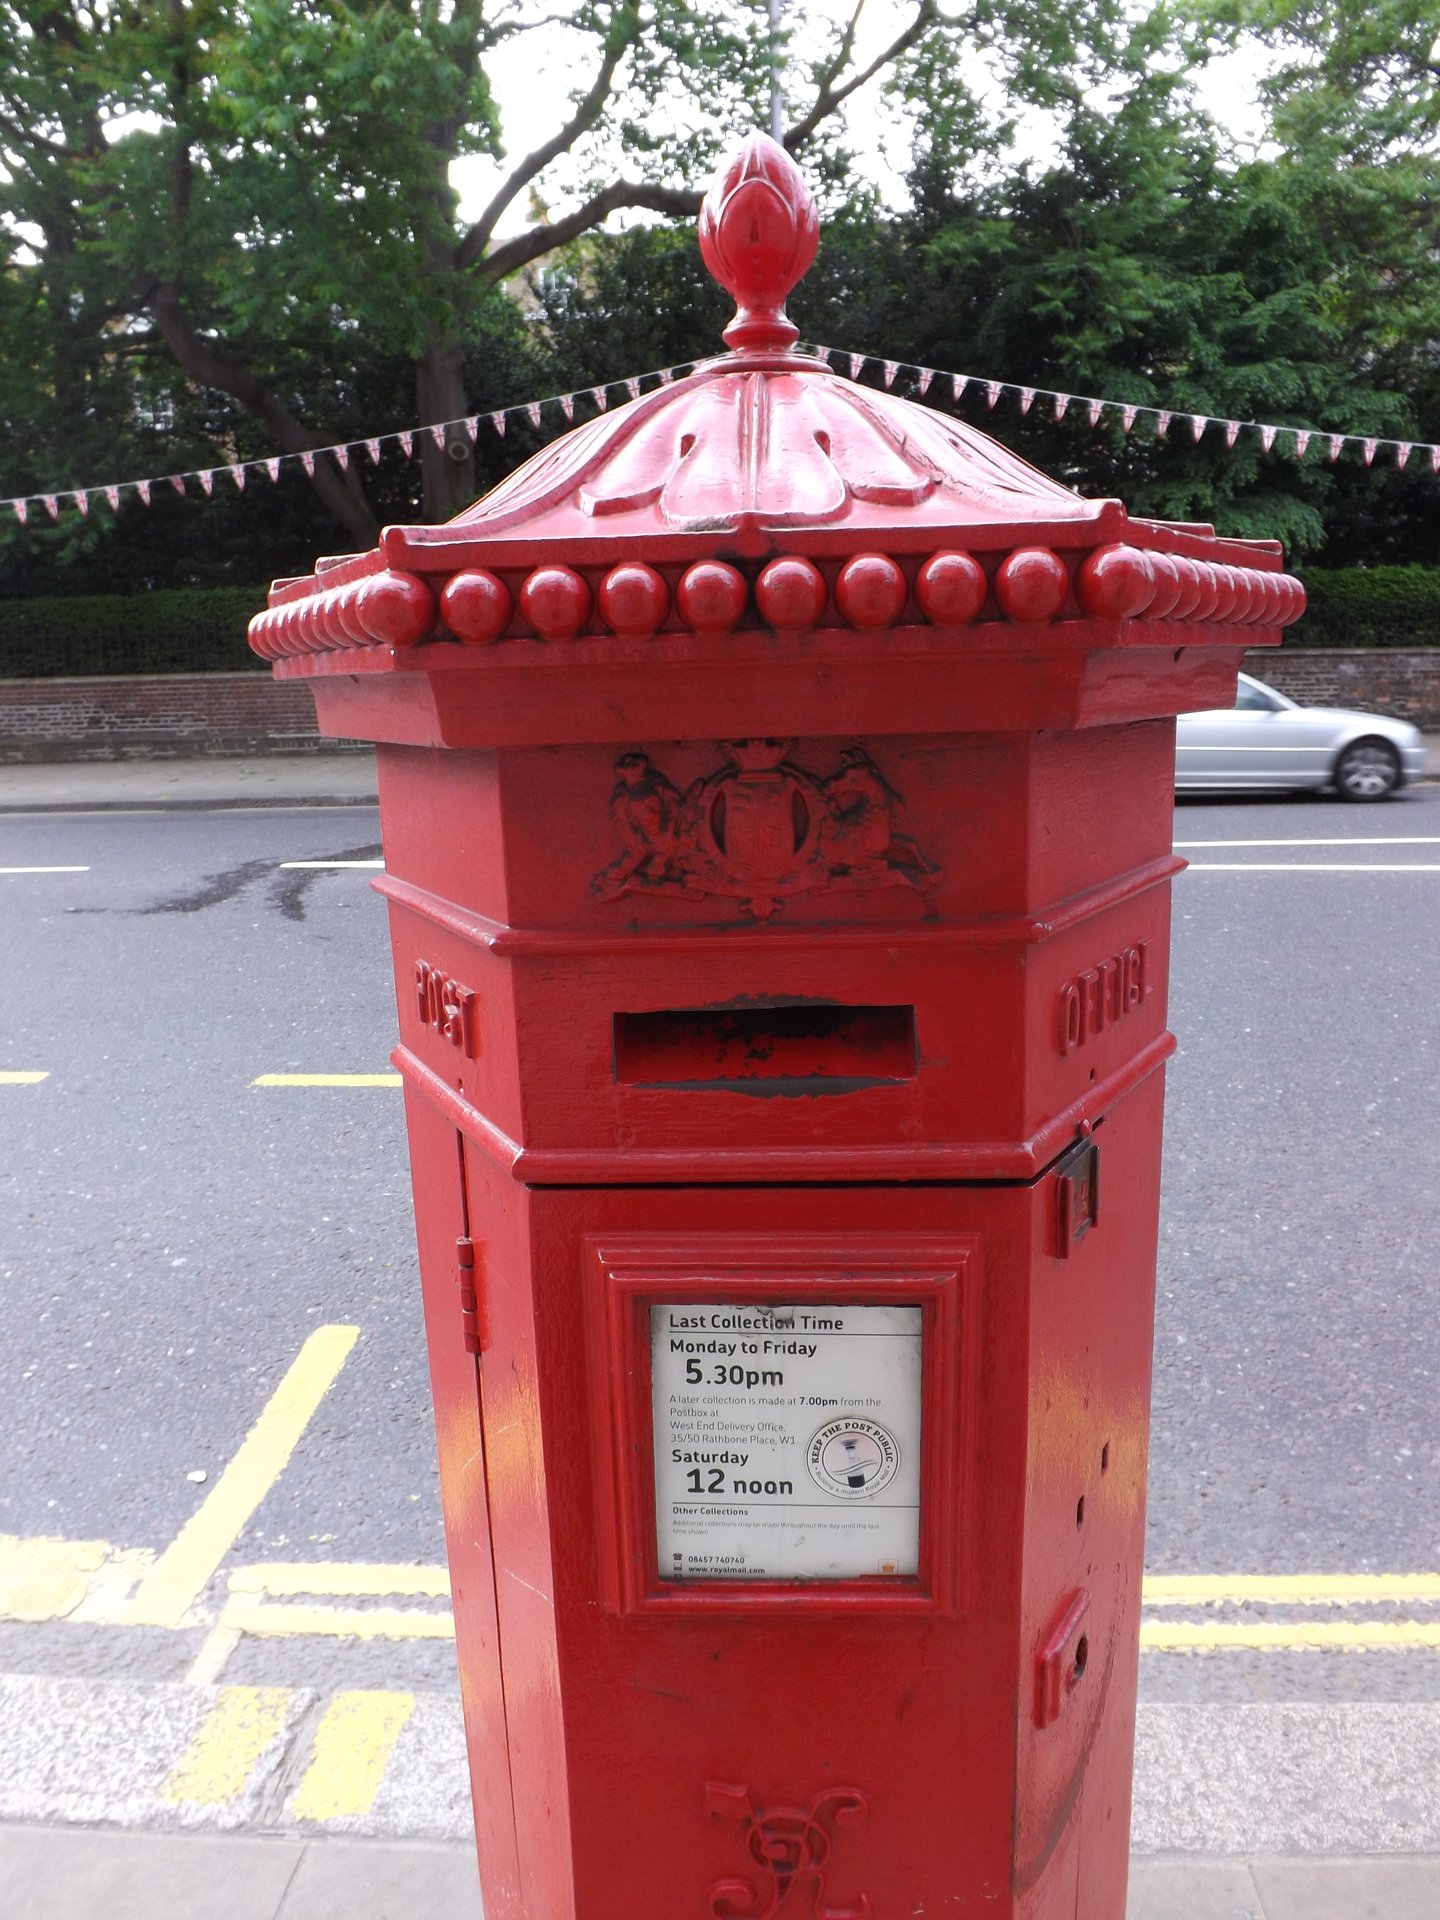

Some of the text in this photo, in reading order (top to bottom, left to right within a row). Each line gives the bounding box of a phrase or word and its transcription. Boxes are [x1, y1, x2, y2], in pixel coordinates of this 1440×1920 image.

[415, 958, 481, 1060] POST
[669, 1314, 844, 1330] Last Collection Time
[670, 1339, 817, 1357] Monday to Friday
[686, 1359, 783, 1389] 5.30pm
[670, 1395, 676, 1404] A
[679, 1395, 699, 1404] later
[702, 1396, 746, 1404] collection
[749, 1397, 756, 1405] is
[759, 1397, 785, 1405] made
[799, 1397, 838, 1407] 7.00pm
[840, 1398, 863, 1406] from
[866, 1398, 881, 1406] the
[670, 1408, 708, 1417] Postbox
[670, 1421, 694, 1430] West
[697, 1421, 714, 1430] End
[717, 1422, 755, 1432] Delivery
[702, 1435, 747, 1444] Rathbone
[812, 1422, 893, 1464] KEEP THE POST PUBLIC
[672, 1449, 748, 1467] Saturday
[687, 1468, 793, 1494] 12 noon
[673, 1507, 748, 1515] Other Collections
[688, 1566, 765, 1574] www.royalmail.com
